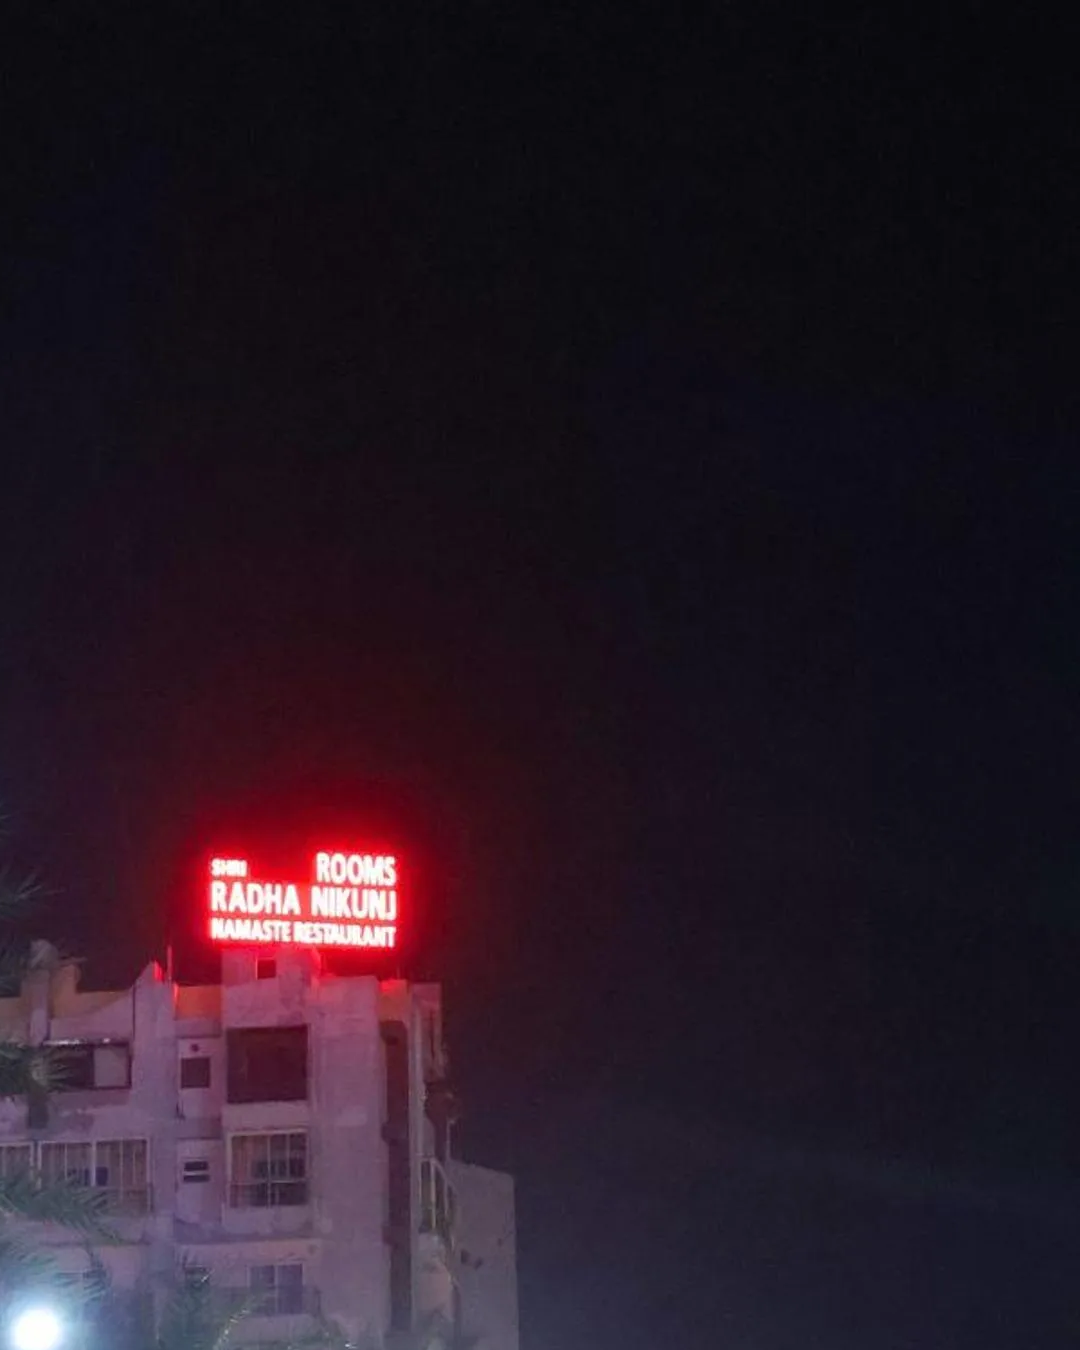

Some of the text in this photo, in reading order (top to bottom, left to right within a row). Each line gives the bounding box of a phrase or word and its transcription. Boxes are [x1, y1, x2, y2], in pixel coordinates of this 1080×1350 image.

[316, 852, 397, 886] ROOMS
[210, 881, 397, 920] RADHA NIKUNJ
[210, 918, 396, 948] NAMASTE RESTAURANT
